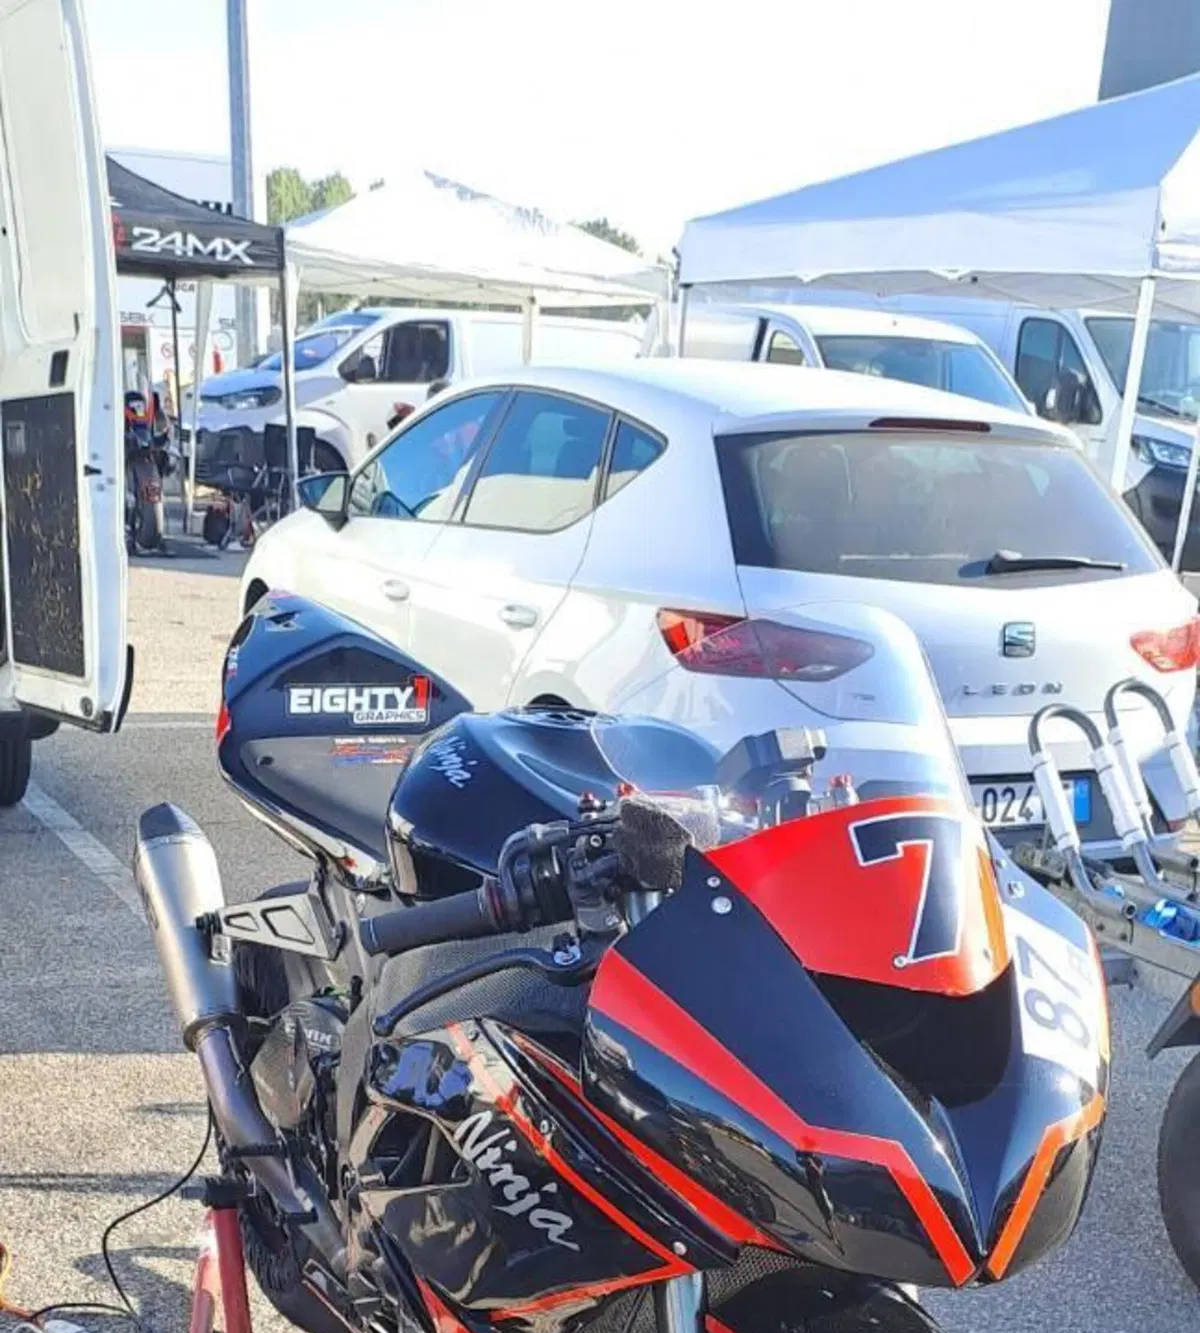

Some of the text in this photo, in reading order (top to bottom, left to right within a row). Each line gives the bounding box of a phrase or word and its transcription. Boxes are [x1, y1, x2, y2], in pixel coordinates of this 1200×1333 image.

[131, 226, 255, 265] 24MX
[962, 682, 1064, 697] LEON
[355, 710, 425, 722] GRAPHICS
[848, 810, 966, 964] 7
[453, 1110, 580, 1251] Ninja
